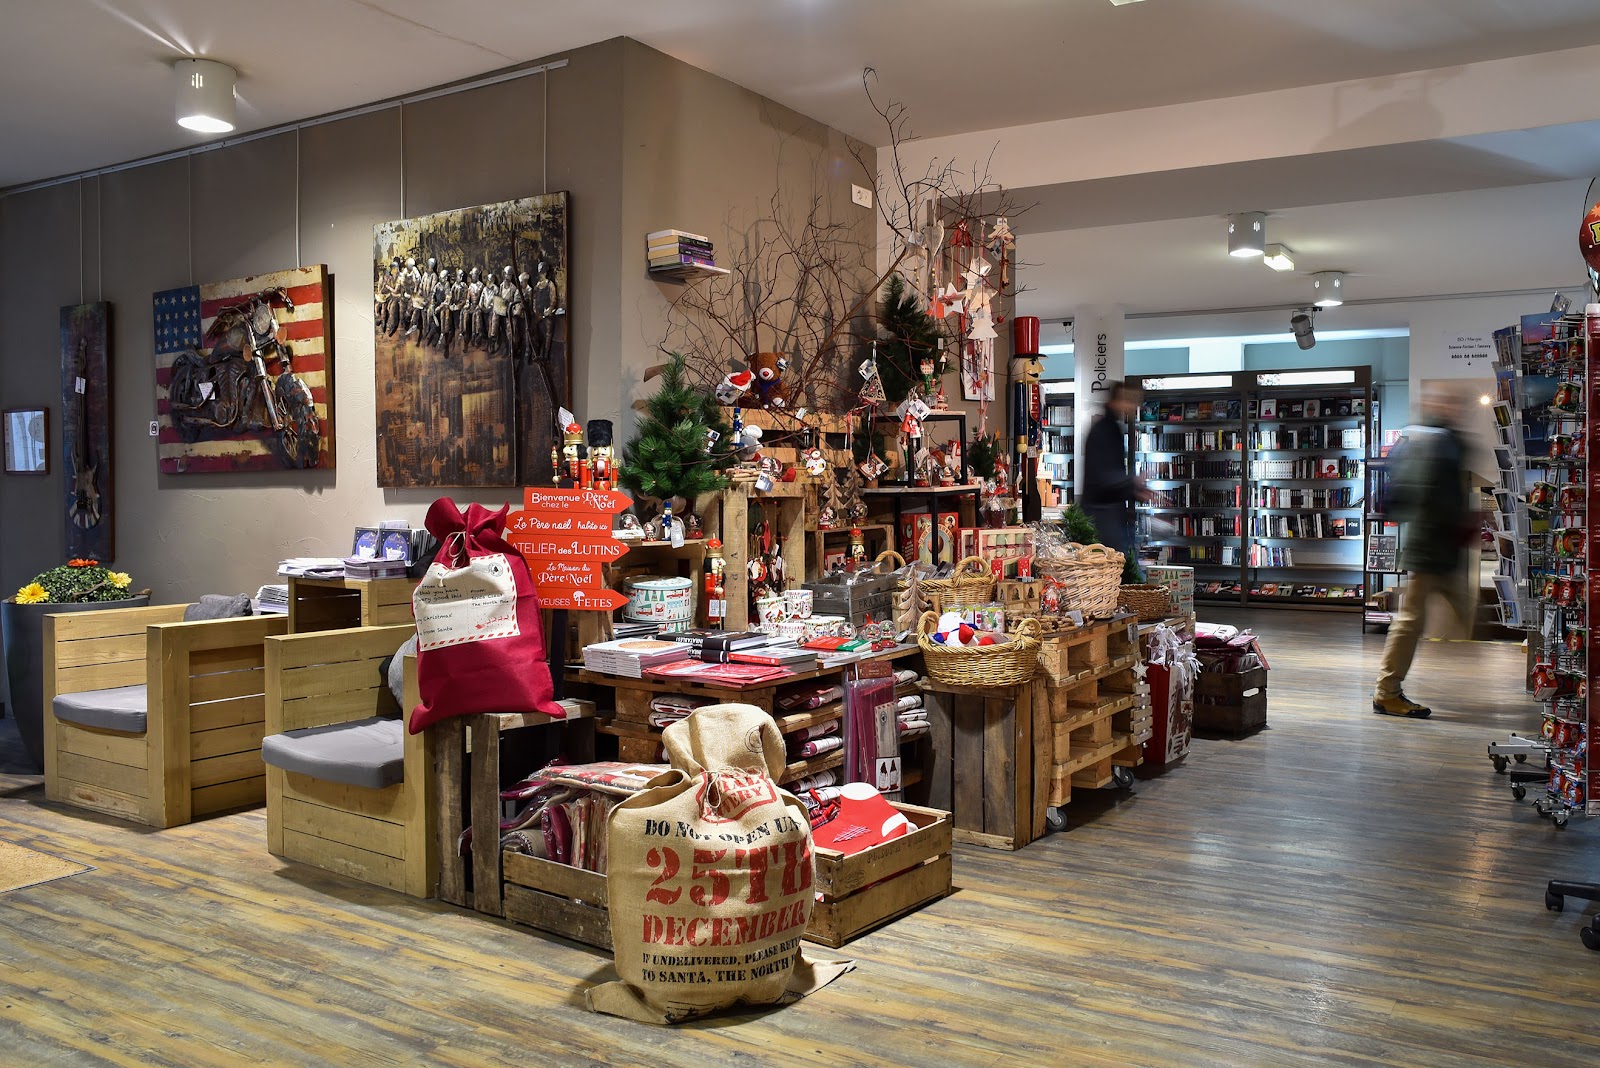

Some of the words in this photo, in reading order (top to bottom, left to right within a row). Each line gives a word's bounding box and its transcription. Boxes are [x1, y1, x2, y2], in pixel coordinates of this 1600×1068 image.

[1091, 333, 1110, 393] Policiers
[532, 492, 580, 504] Bienvenue
[541, 500, 560, 508] chez
[582, 492, 609, 504] Père
[590, 499, 616, 511] Noël
[514, 517, 527, 530] Le
[577, 520, 598, 530] habite
[571, 541, 620, 556] LUTINS
[581, 564, 591, 572] du
[538, 572, 565, 586] Père
[566, 573, 593, 586] Noël
[539, 598, 571, 606] YEUSES
[858, 593, 888, 608] FRANCE
[644, 818, 671, 836] DO
[645, 835, 812, 907] 25TH
[641, 899, 806, 947] DECEMBER
[745, 943, 778, 965] PLEASE
[642, 968, 655, 982] TO
[659, 970, 712, 985] SANTA,
[715, 967, 747, 982] THE
[750, 957, 790, 981] NORTH
